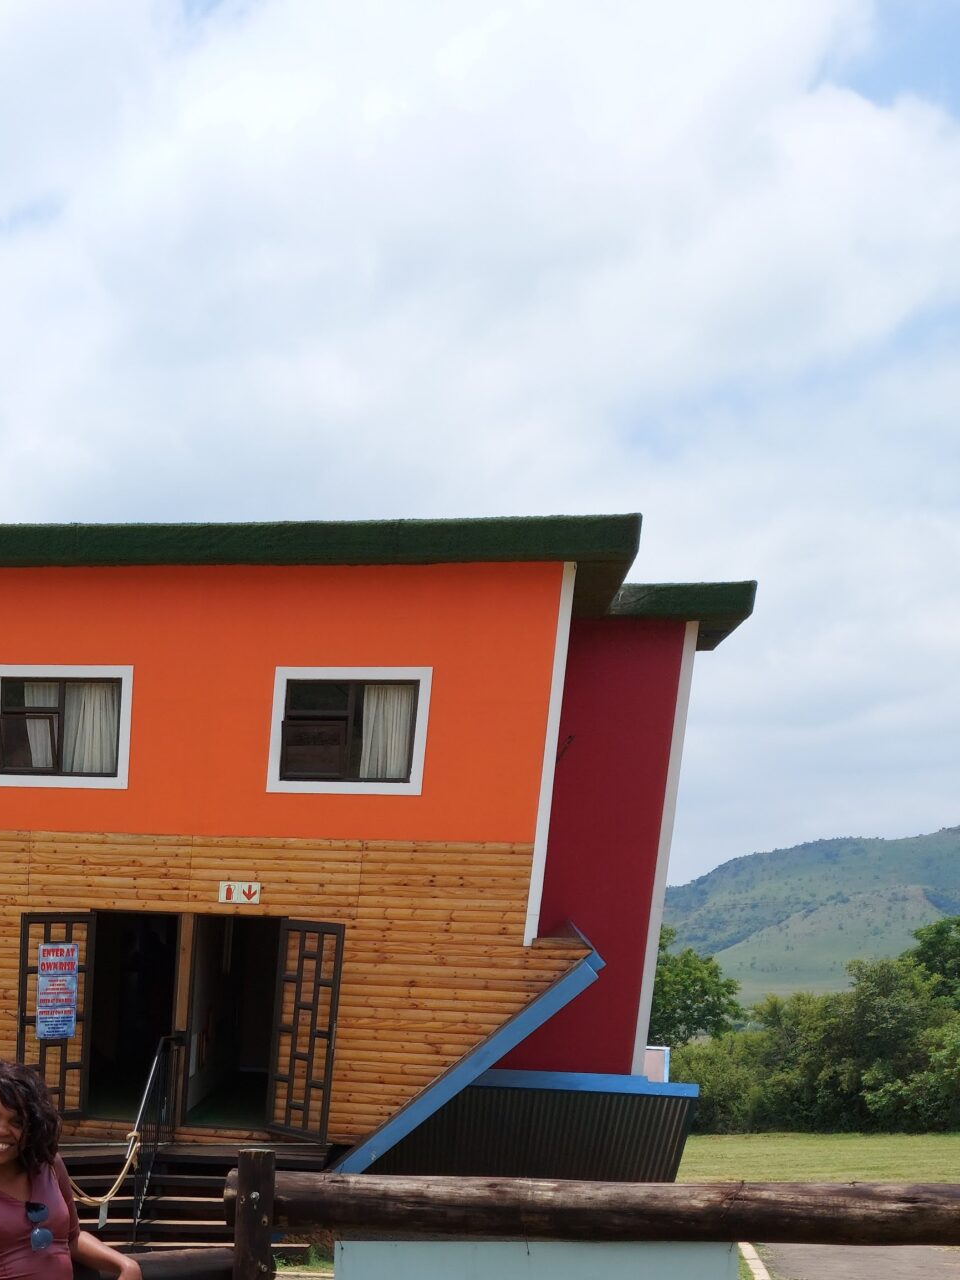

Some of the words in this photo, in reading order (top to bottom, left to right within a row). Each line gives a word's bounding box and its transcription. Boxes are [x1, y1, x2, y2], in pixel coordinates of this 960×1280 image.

[42, 948, 64, 957] ENTER
[66, 948, 75, 957] AT
[41, 962, 58, 971] OWN
[59, 962, 76, 971] RISK
